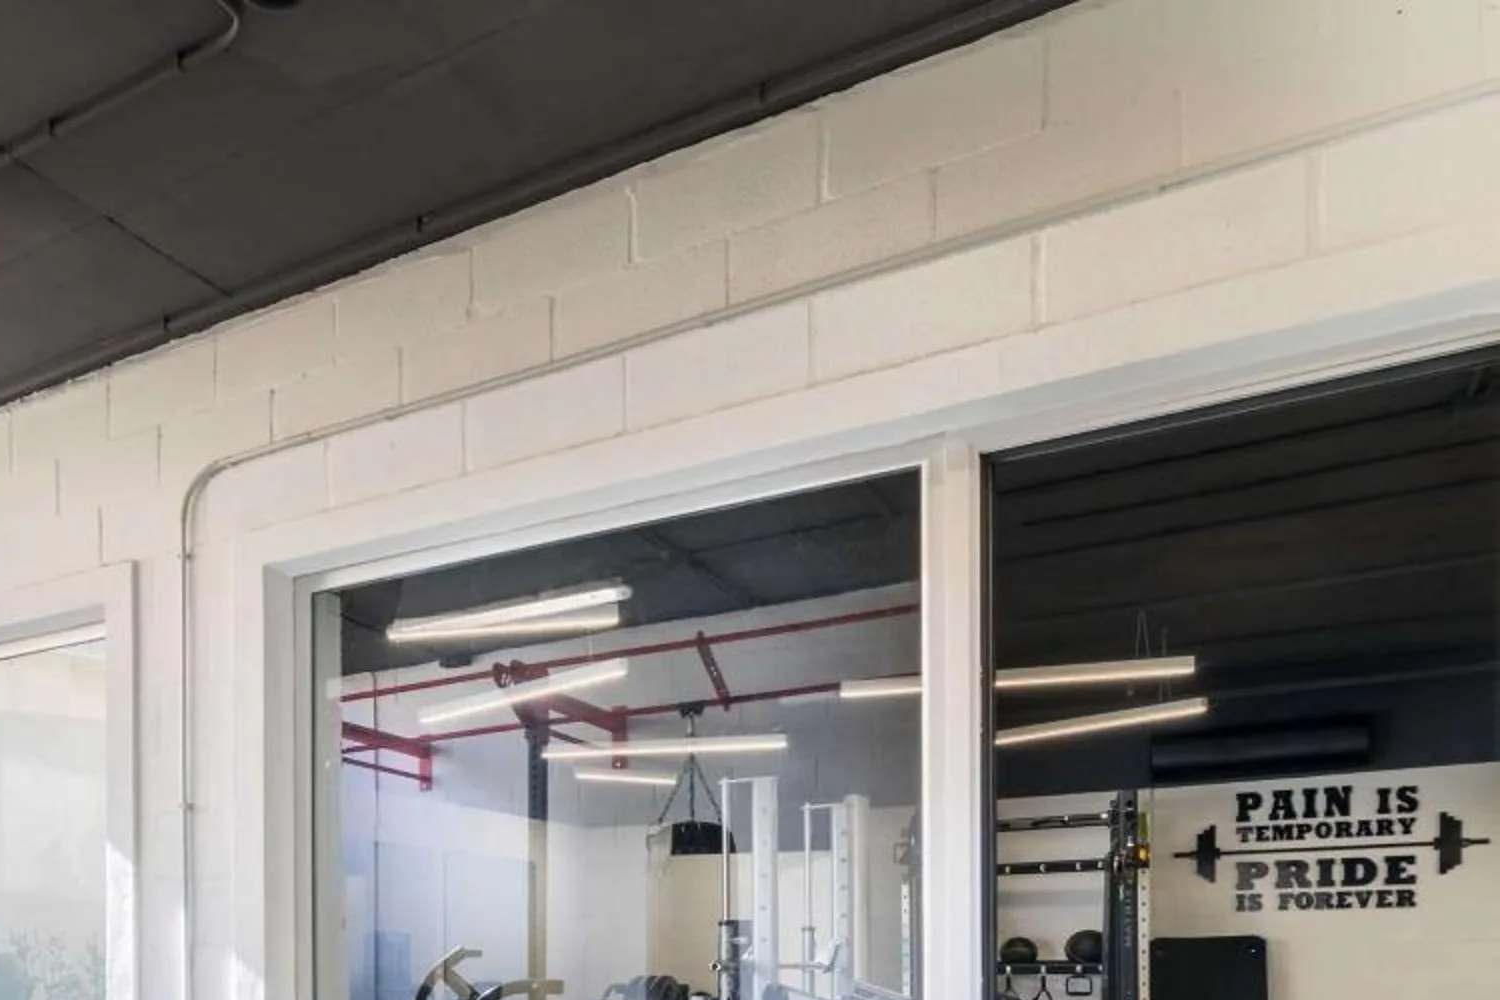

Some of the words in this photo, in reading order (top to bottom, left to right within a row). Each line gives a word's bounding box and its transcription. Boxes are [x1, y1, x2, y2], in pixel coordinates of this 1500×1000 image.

[1235, 786, 1353, 822] PAIN
[1377, 786, 1419, 815] IS
[1236, 818, 1417, 843] TEMPORARY
[1235, 855, 1418, 890] PRIDE
[1235, 894, 1263, 912] IS
[1278, 890, 1417, 911] FOREVER
